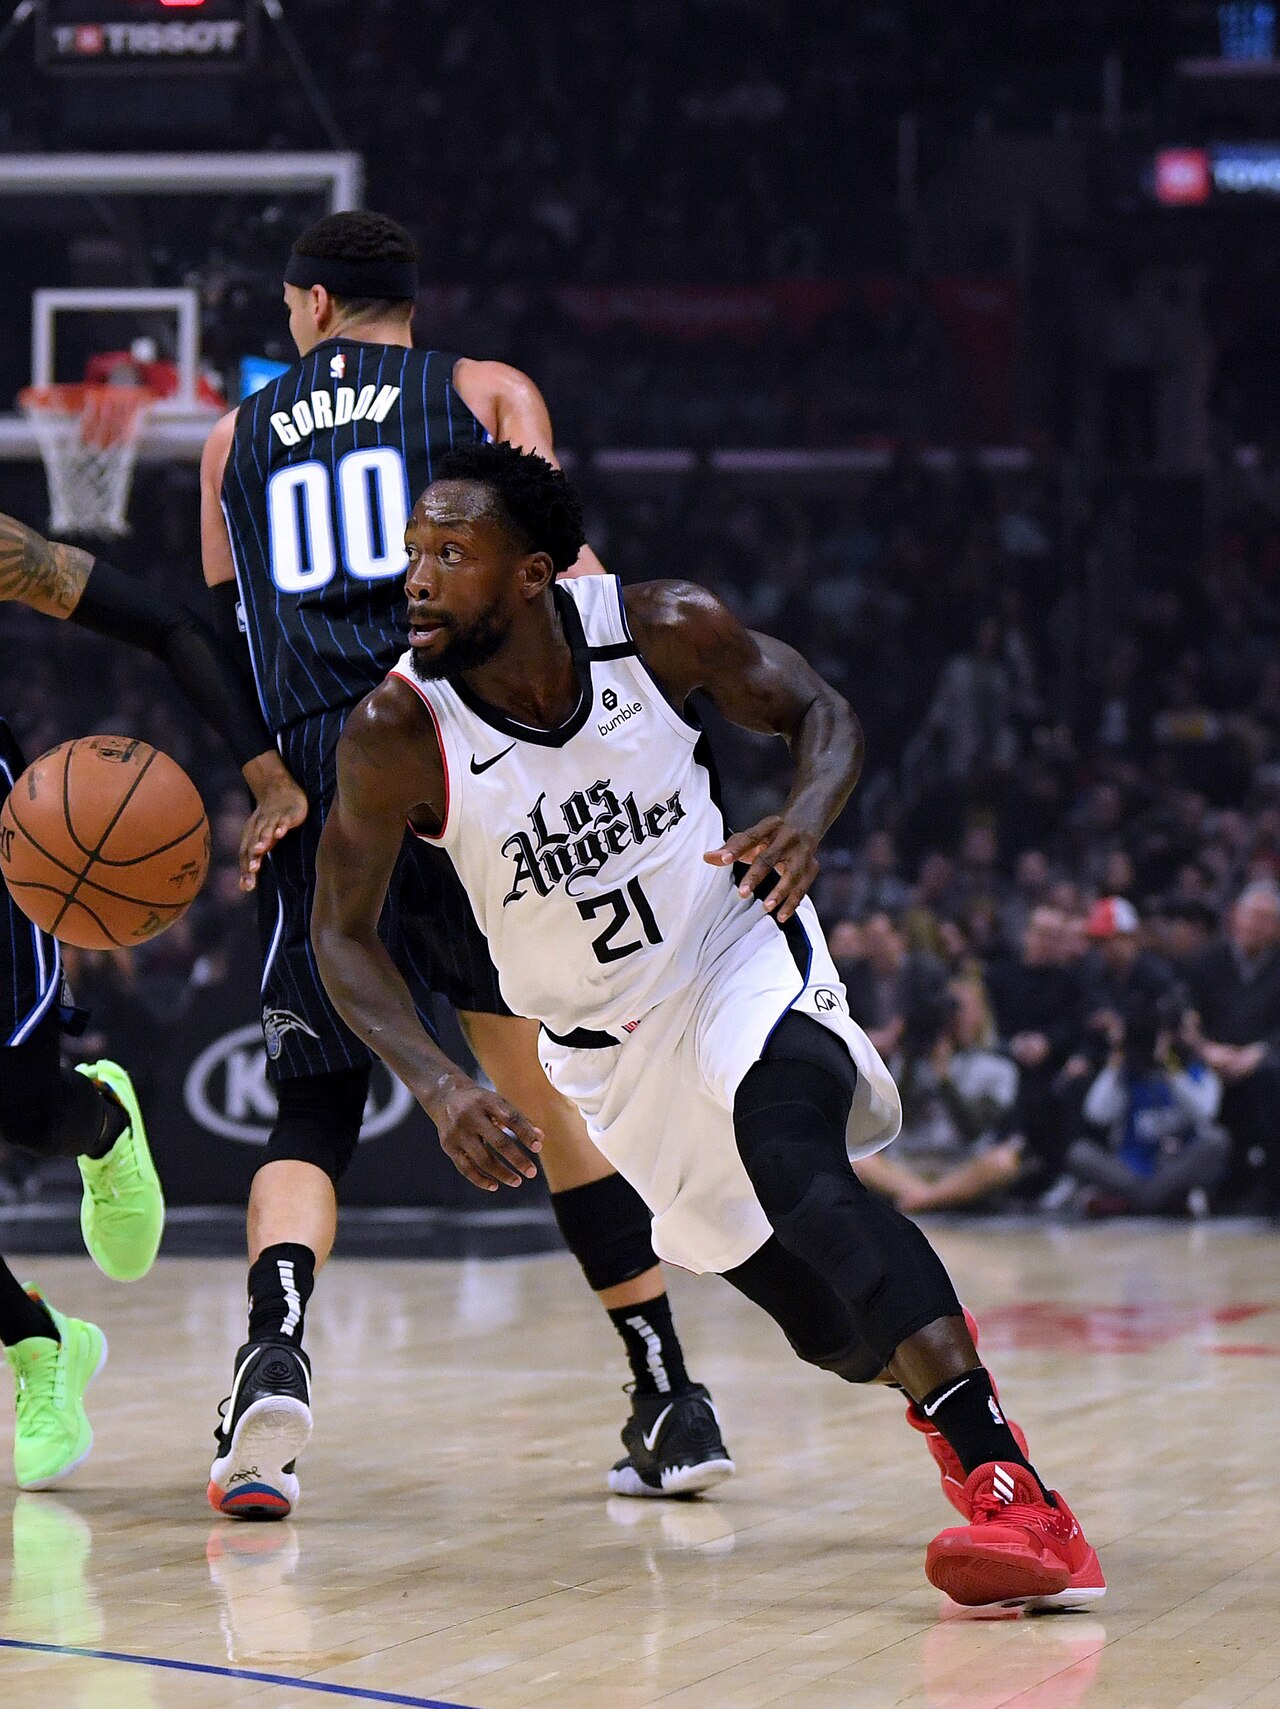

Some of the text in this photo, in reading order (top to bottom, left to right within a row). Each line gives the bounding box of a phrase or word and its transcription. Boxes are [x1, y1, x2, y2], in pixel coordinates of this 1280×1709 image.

[105, 20, 241, 54] TISSOT
[270, 384, 401, 446] GORDON
[267, 447, 410, 593] 00
[597, 700, 643, 736] bumble
[501, 788, 687, 908] Angeles
[527, 779, 621, 853] Los
[576, 875, 664, 964] 21
